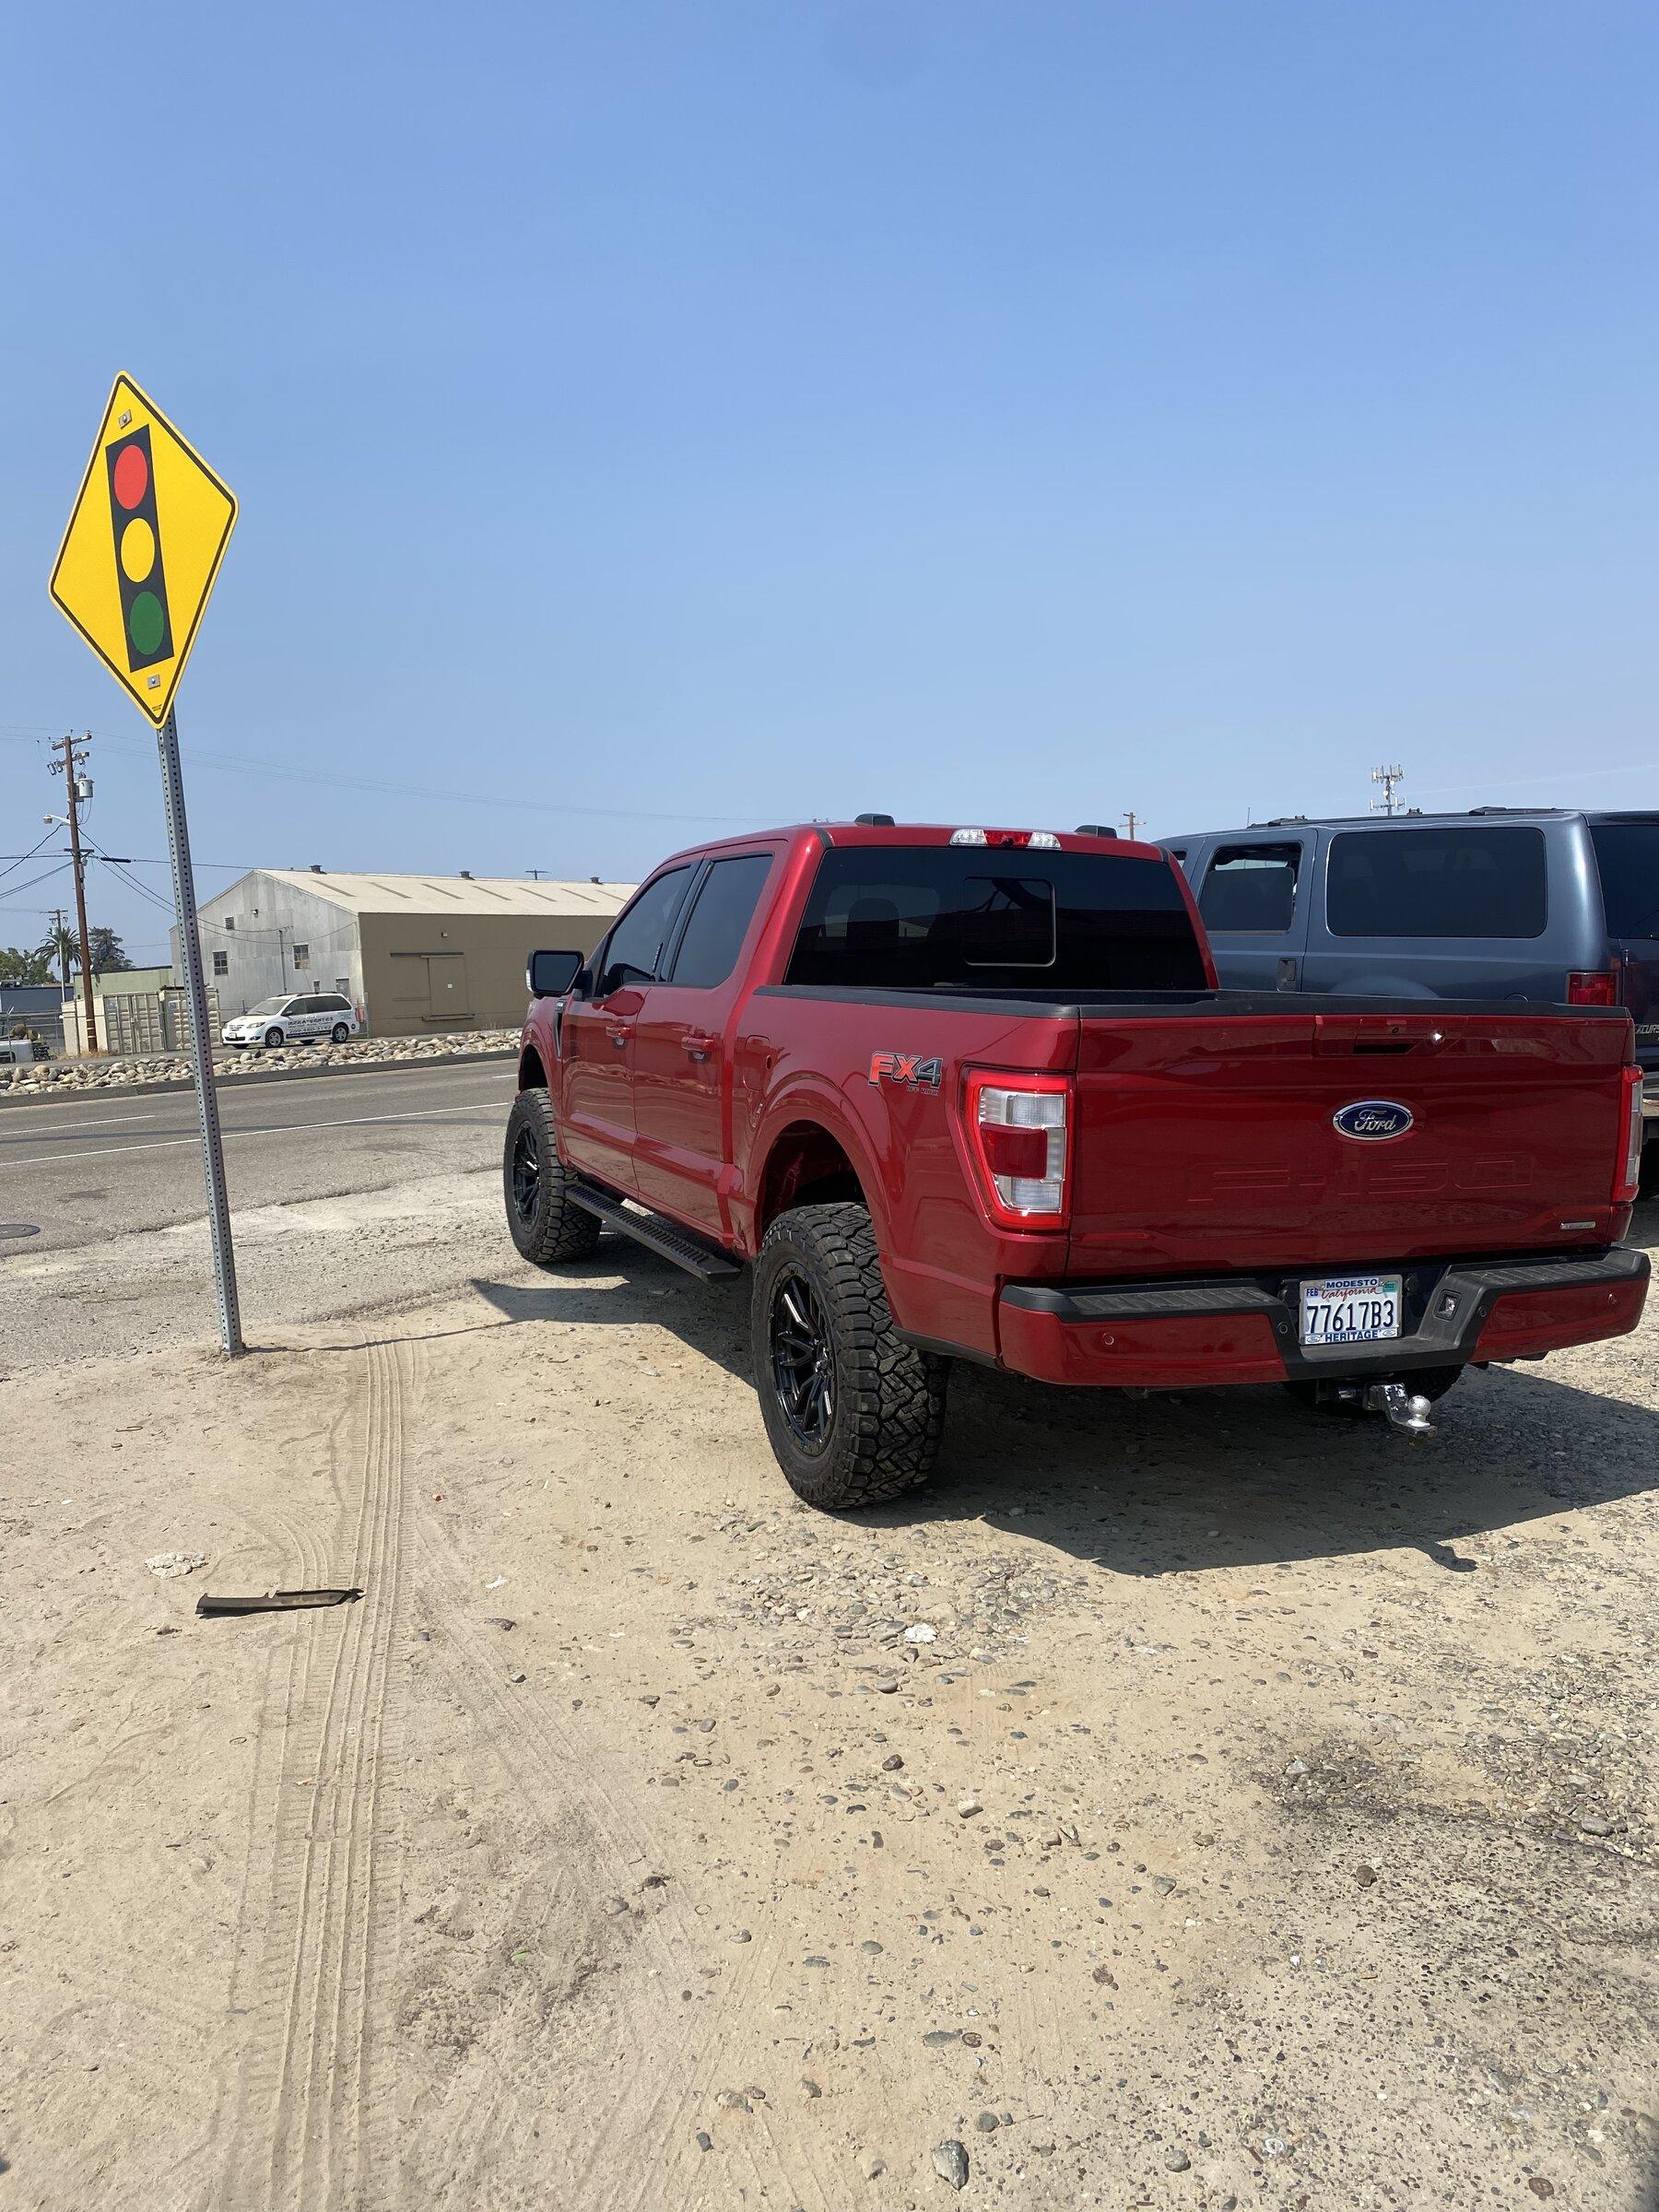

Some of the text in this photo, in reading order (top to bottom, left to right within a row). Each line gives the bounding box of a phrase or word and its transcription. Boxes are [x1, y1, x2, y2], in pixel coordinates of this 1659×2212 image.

[868, 1051, 943, 1088] FX4
[1354, 1109, 1397, 1132] Ford
[1325, 1278, 1378, 1288] MODESTO
[1306, 1288, 1319, 1297] FEB
[1321, 1287, 1382, 1302] California
[1306, 1300, 1394, 1335] 77617B3
[1324, 1330, 1379, 1342] HERITAGE
